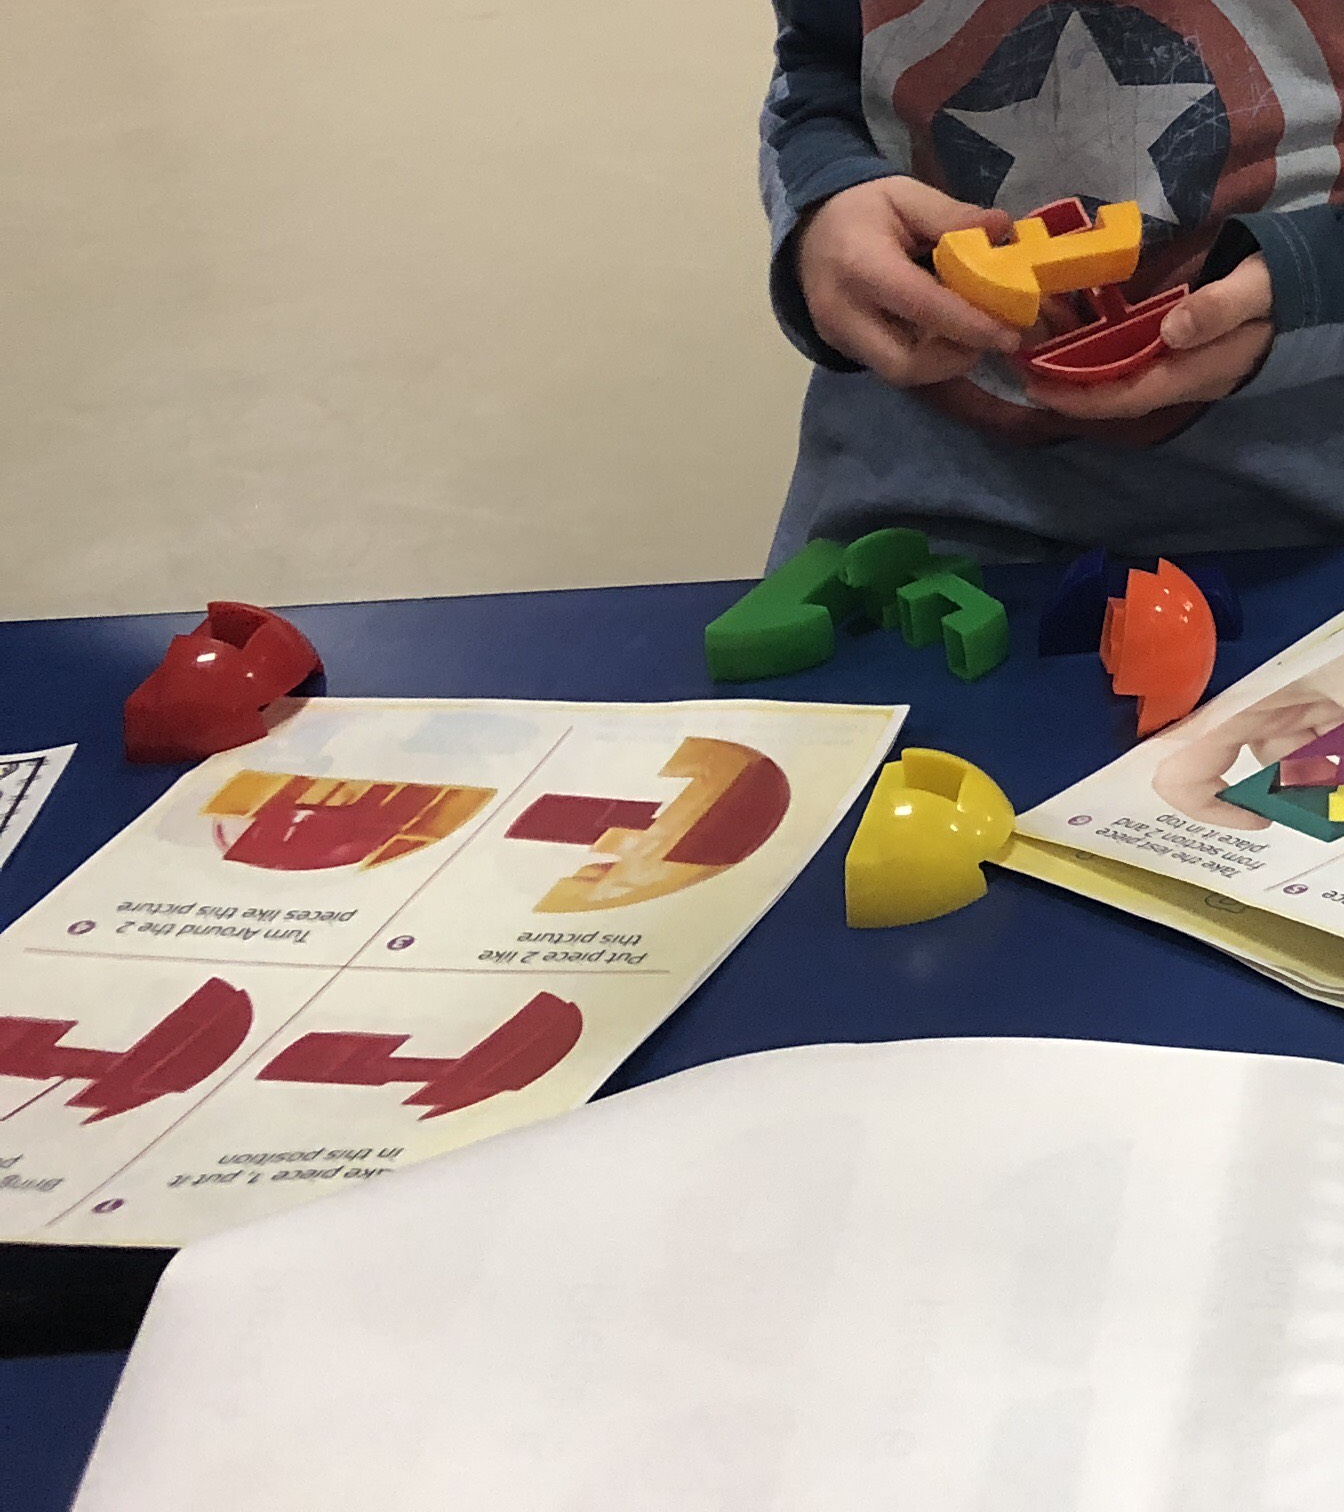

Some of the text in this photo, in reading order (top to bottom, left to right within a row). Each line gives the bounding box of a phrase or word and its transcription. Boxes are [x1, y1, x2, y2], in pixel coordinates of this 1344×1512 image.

[1108, 816, 1150, 833] and
[1154, 813, 1187, 830] top
[1160, 831, 1226, 858] section
[1216, 833, 1271, 855] place
[1220, 849, 1267, 872] from
[113, 900, 360, 927] pieces like this picture
[113, 920, 312, 945] Turn Around the 2
[515, 931, 643, 948] this picture
[476, 949, 648, 966] Put piece 2 like
[215, 1146, 405, 1169] in this position
[271, 1165, 346, 1186] piece
[343, 1166, 394, 1181] ake
